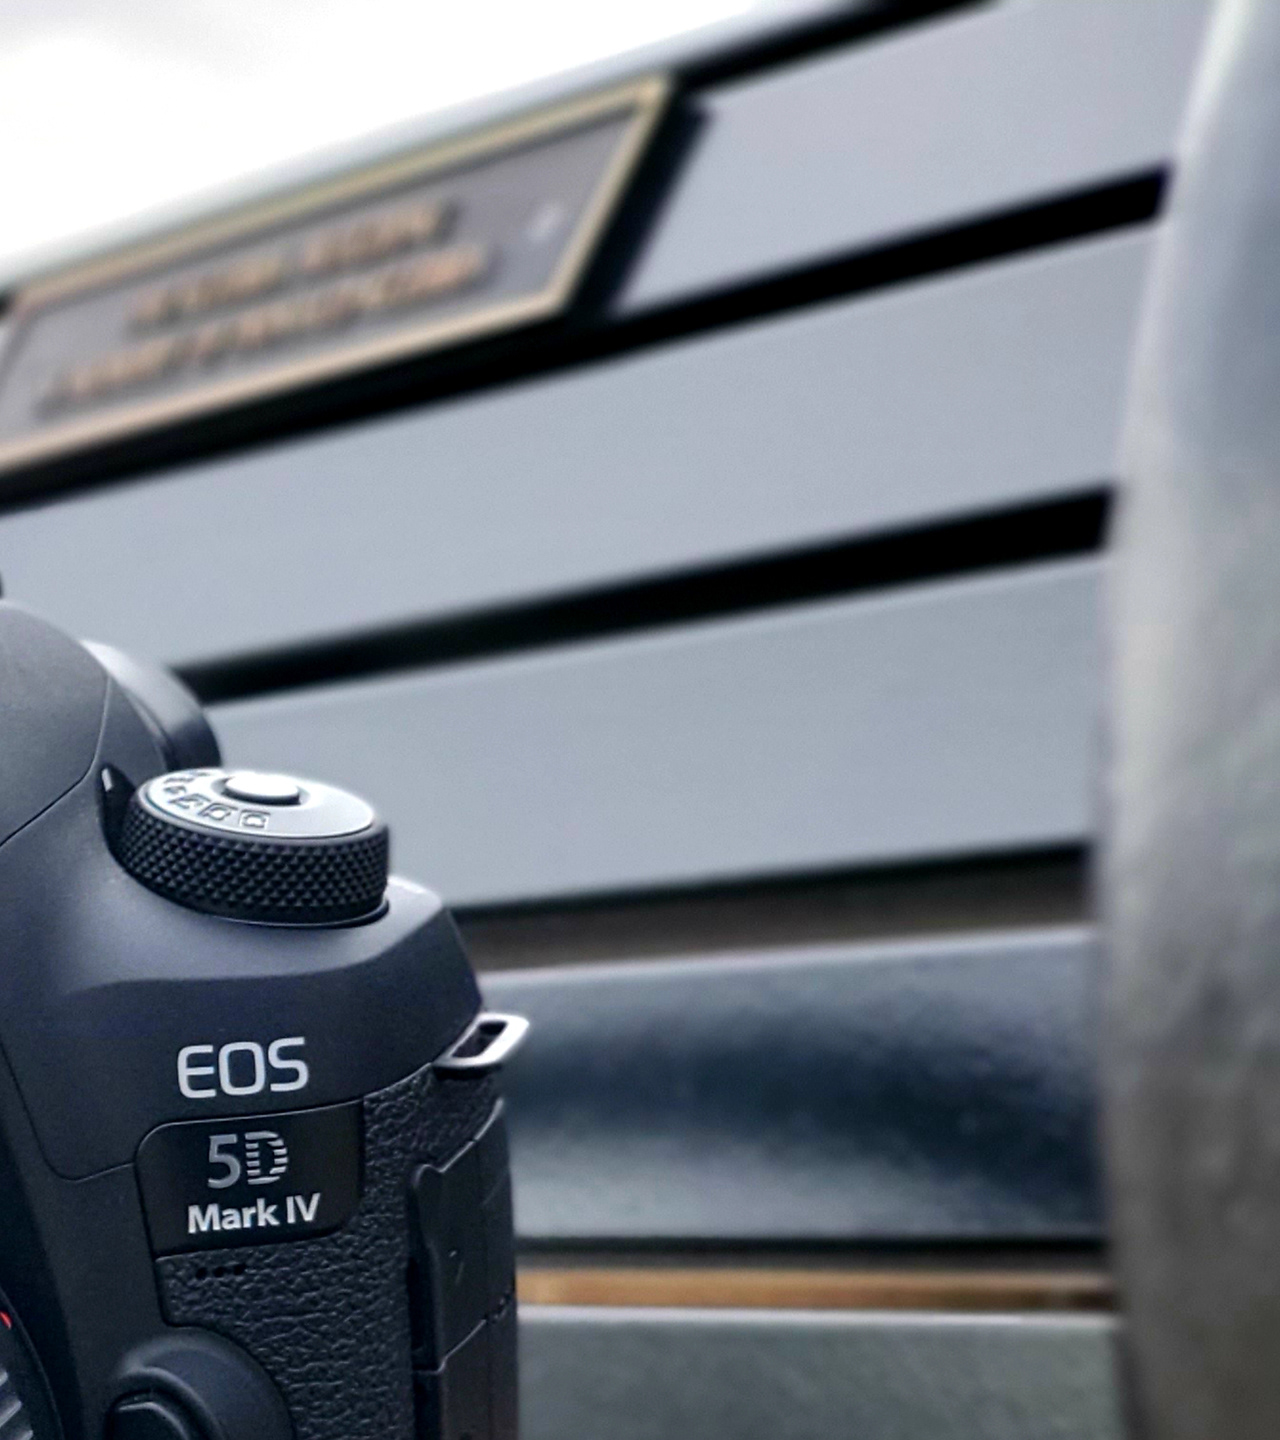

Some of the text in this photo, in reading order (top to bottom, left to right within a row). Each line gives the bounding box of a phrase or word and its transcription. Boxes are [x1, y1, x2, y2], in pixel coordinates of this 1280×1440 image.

[177, 1036, 309, 1099] EOS
[207, 1130, 289, 1189] 5D
[187, 1192, 322, 1235] Mark IV
